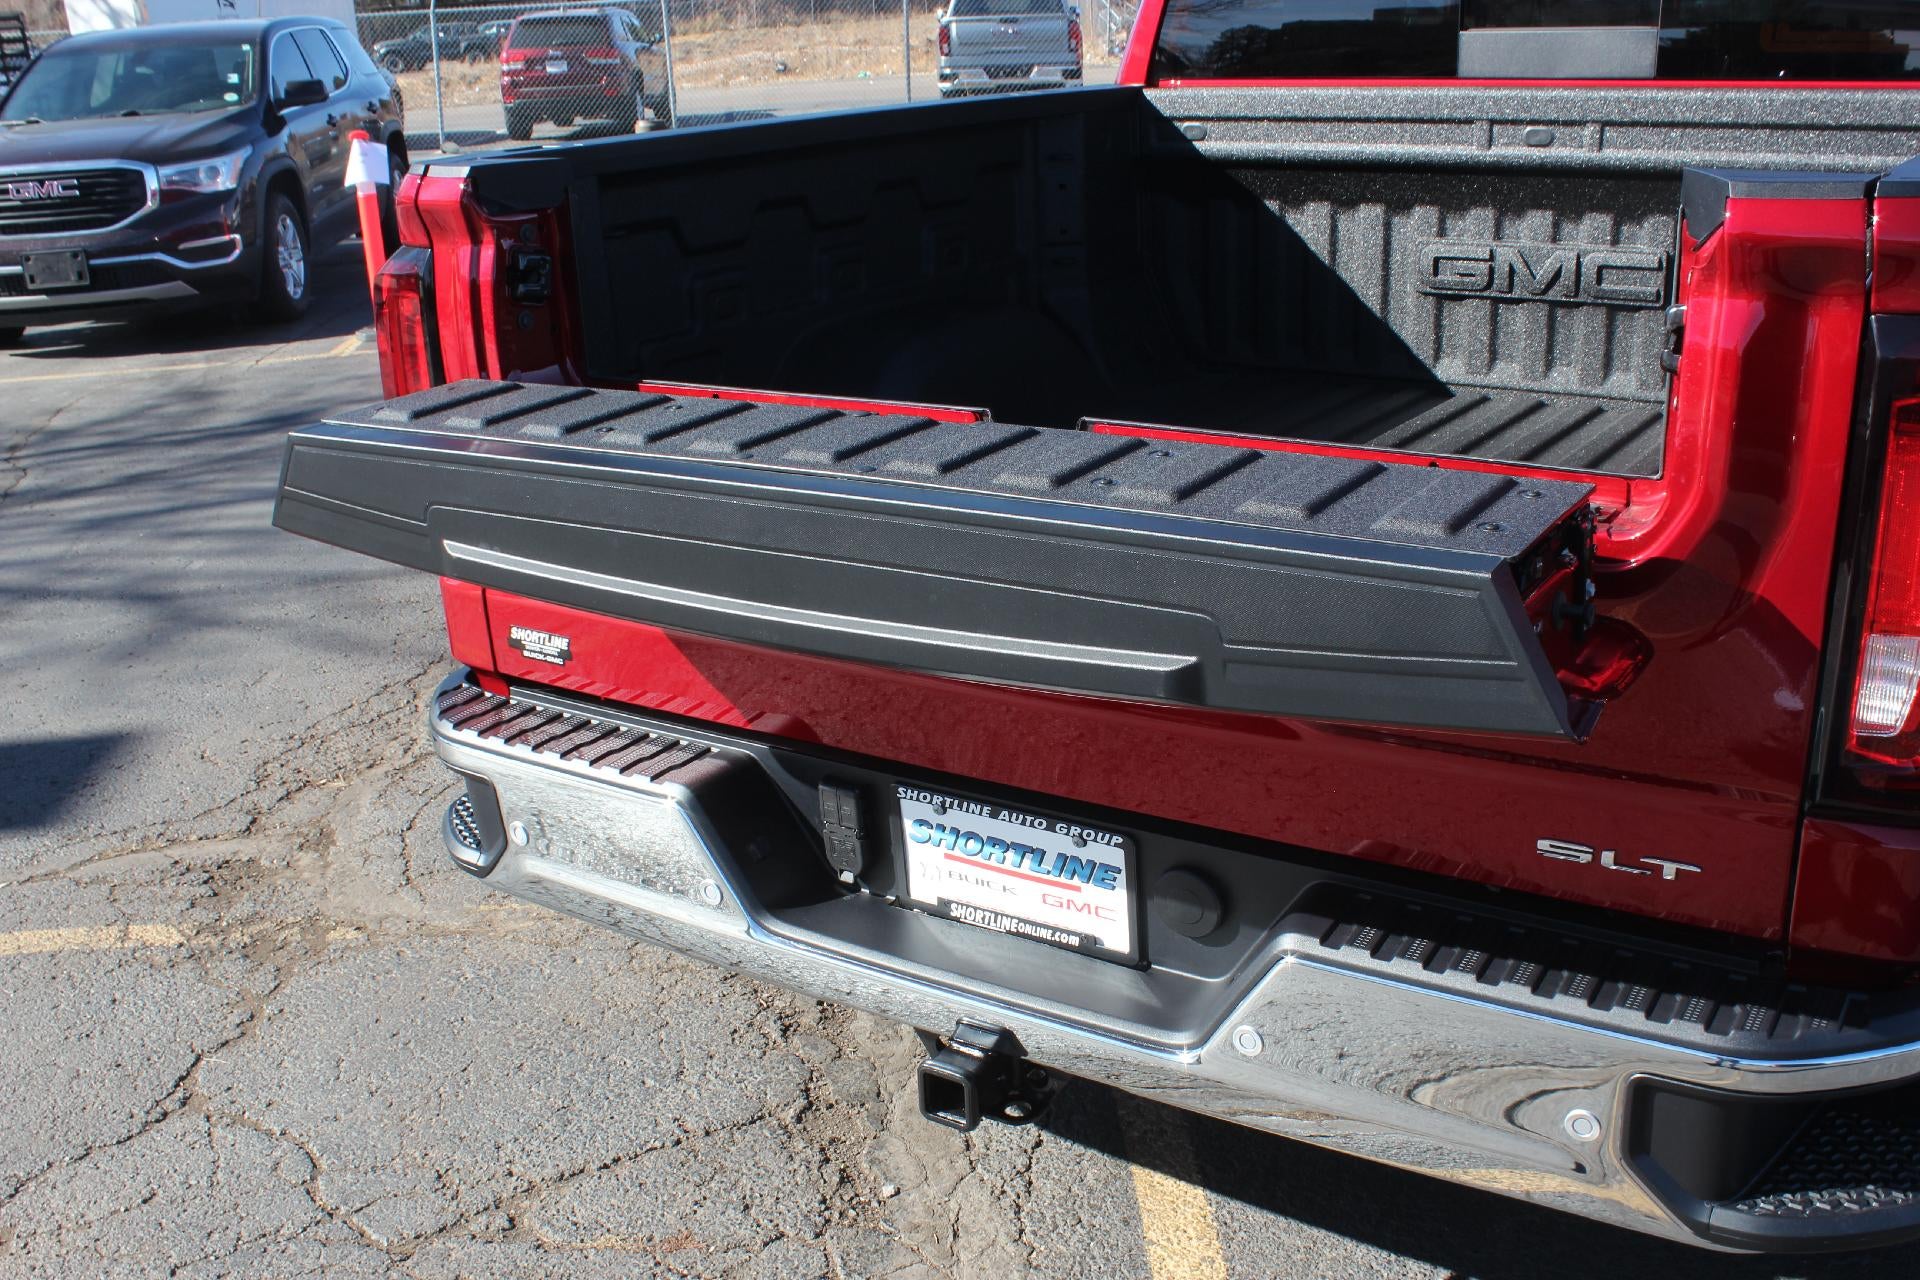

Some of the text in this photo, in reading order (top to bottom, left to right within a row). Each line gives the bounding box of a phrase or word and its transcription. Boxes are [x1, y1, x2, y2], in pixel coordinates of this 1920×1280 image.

[8, 179, 80, 200] GMC
[1422, 246, 1668, 303] GMC
[510, 626, 569, 650] SHORTLINE
[896, 787, 1124, 847] SHORTLINE AUTO GROUP
[909, 818, 1122, 891] SHORTLINE
[1536, 839, 1702, 881] SLT
[948, 870, 1118, 922] BUICK GMC
